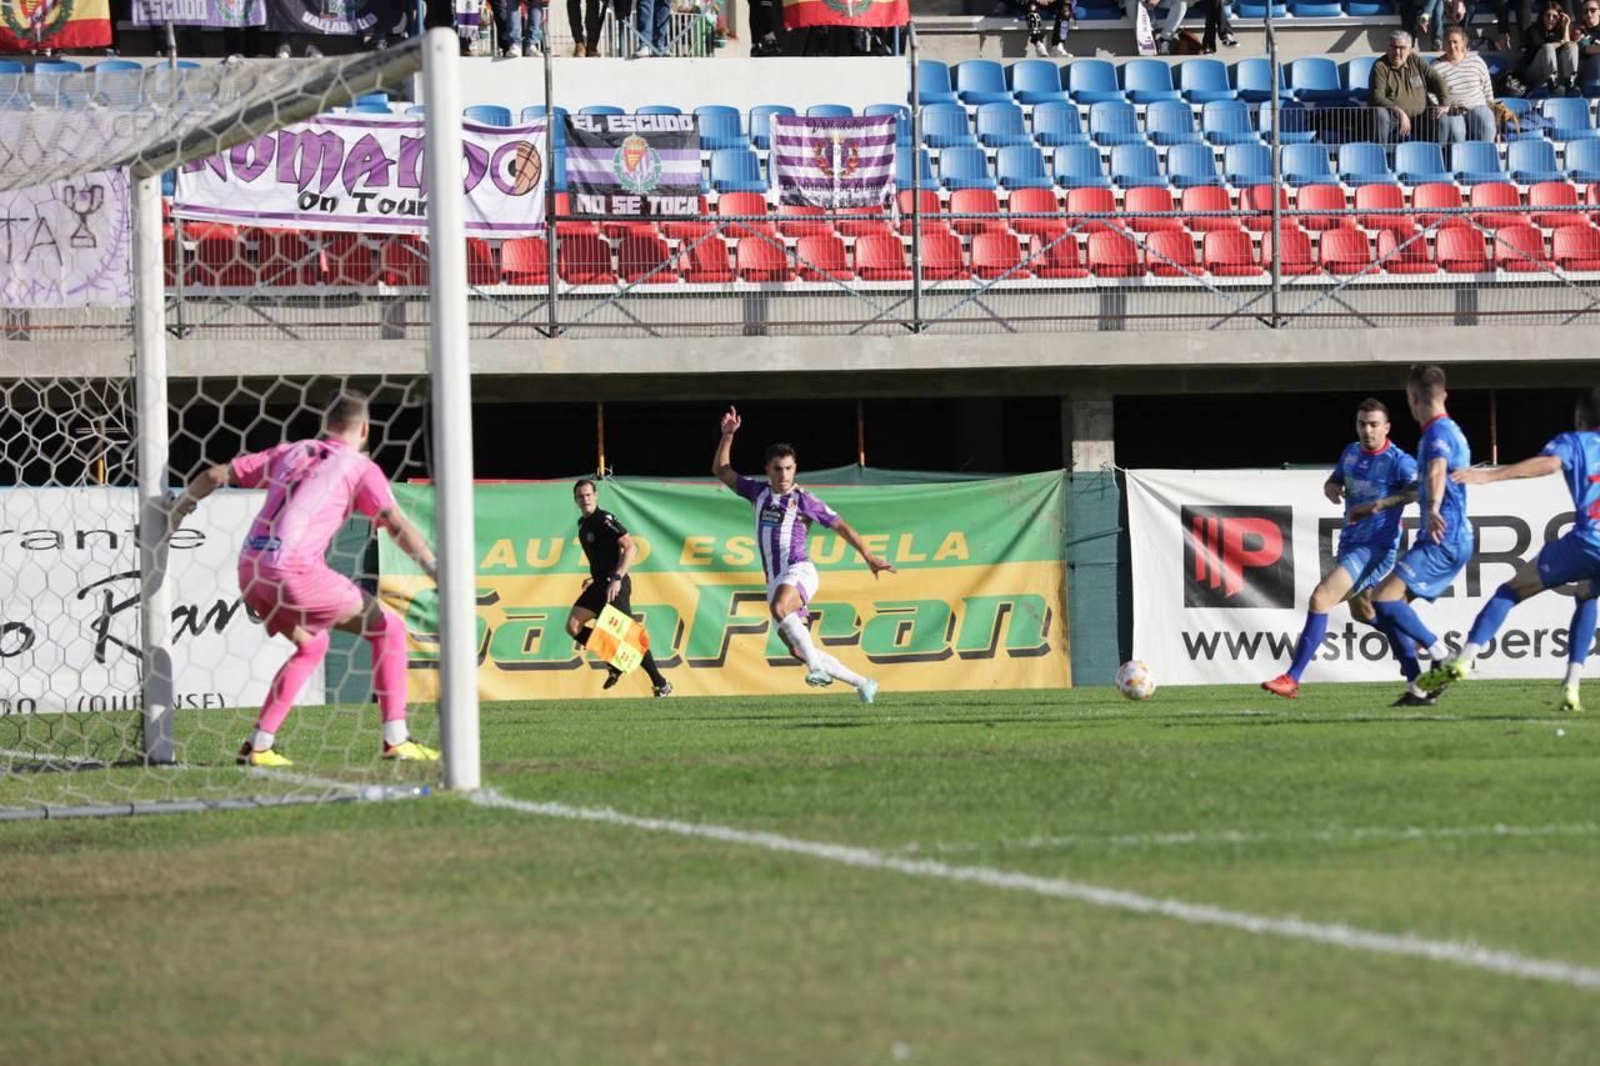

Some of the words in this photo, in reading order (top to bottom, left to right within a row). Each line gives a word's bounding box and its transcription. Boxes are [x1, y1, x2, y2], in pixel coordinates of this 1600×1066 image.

[570, 114, 602, 132] EL
[607, 115, 694, 132] ESCUDO
[577, 194, 606, 215] NO
[611, 195, 641, 215] SE
[648, 196, 700, 216] TOCA
[679, 531, 970, 568] ESUELA
